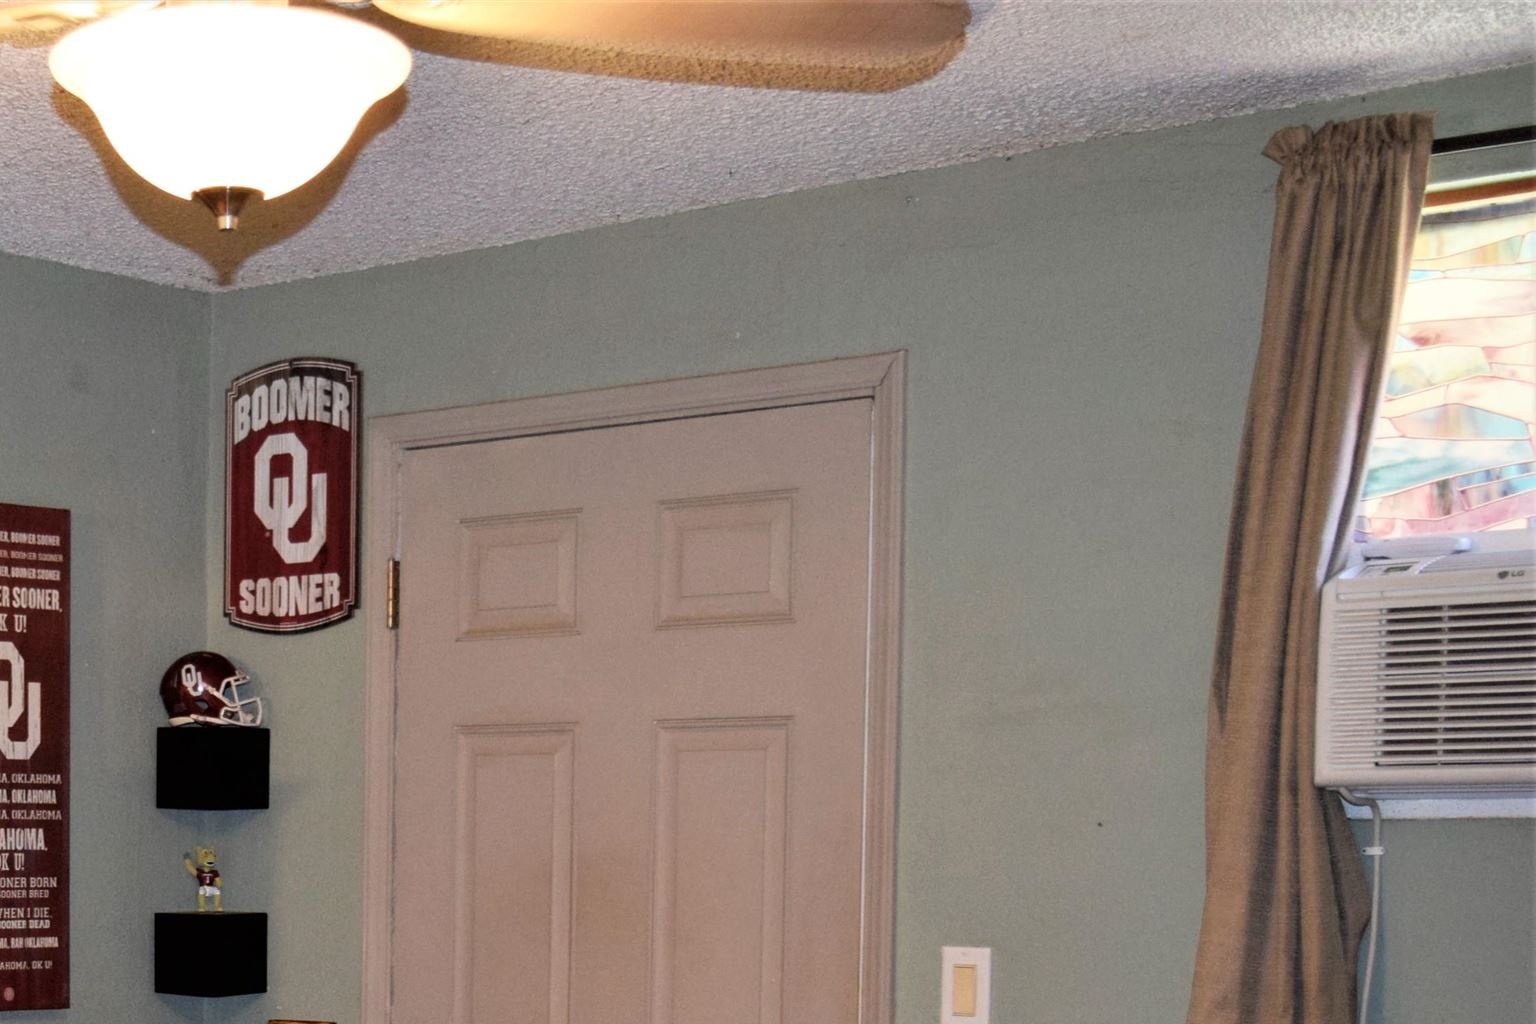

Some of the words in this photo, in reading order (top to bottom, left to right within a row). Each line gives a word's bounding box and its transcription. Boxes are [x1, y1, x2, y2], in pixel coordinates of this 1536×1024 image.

[234, 375, 350, 445] BOOMER
[253, 432, 328, 564] OU
[11, 531, 36, 544] BOOMER
[37, 533, 60, 547] SOONER
[11, 566, 36, 579] BOOMER
[37, 568, 61, 581] SOONER
[12, 586, 63, 613] SOONER,
[239, 572, 341, 617] SOONER
[13, 613, 27, 633] U!
[181, 663, 204, 697] OU
[11, 773, 62, 784] OKLAHOMA
[11, 789, 57, 804] OKLAHOMA
[11, 809, 62, 821] OKLAHOMA
[14, 852, 25, 871] U!
[30, 876, 57, 888] BORN
[28, 889, 49, 898] BRED
[26, 907, 31, 918] I
[28, 919, 50, 929] DEAD
[10, 937, 24, 949] RAH
[25, 936, 59, 948] OKLAHOMA
[31, 960, 43, 970] OK
